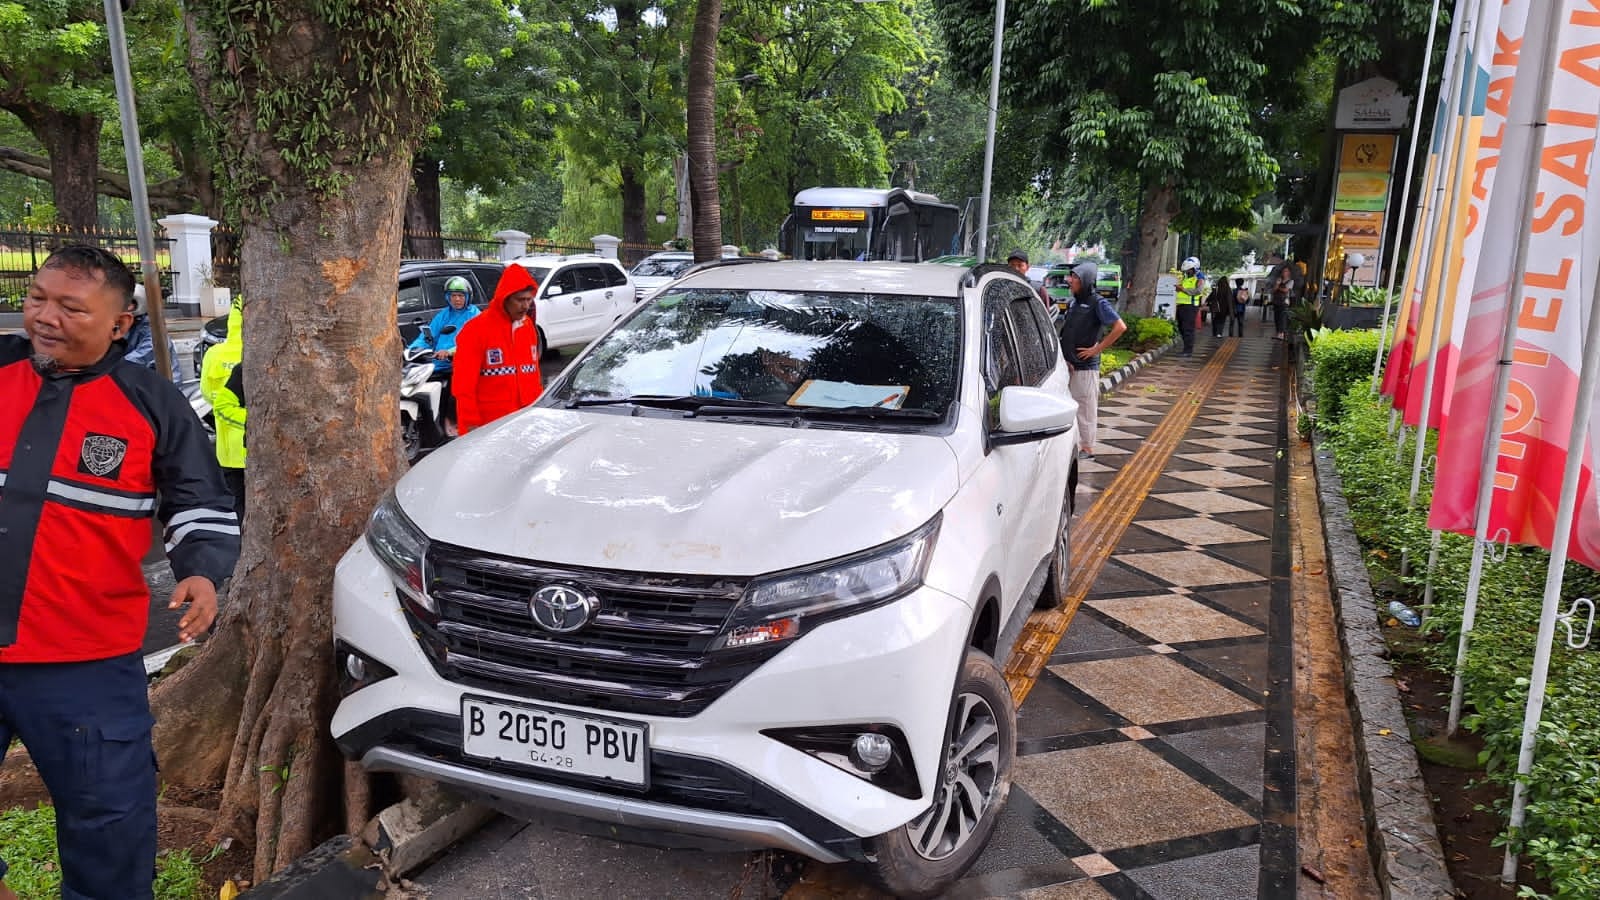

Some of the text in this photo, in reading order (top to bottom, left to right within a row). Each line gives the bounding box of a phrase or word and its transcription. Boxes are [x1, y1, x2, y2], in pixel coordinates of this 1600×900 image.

[470, 706, 638, 763] B 2050 PBV
